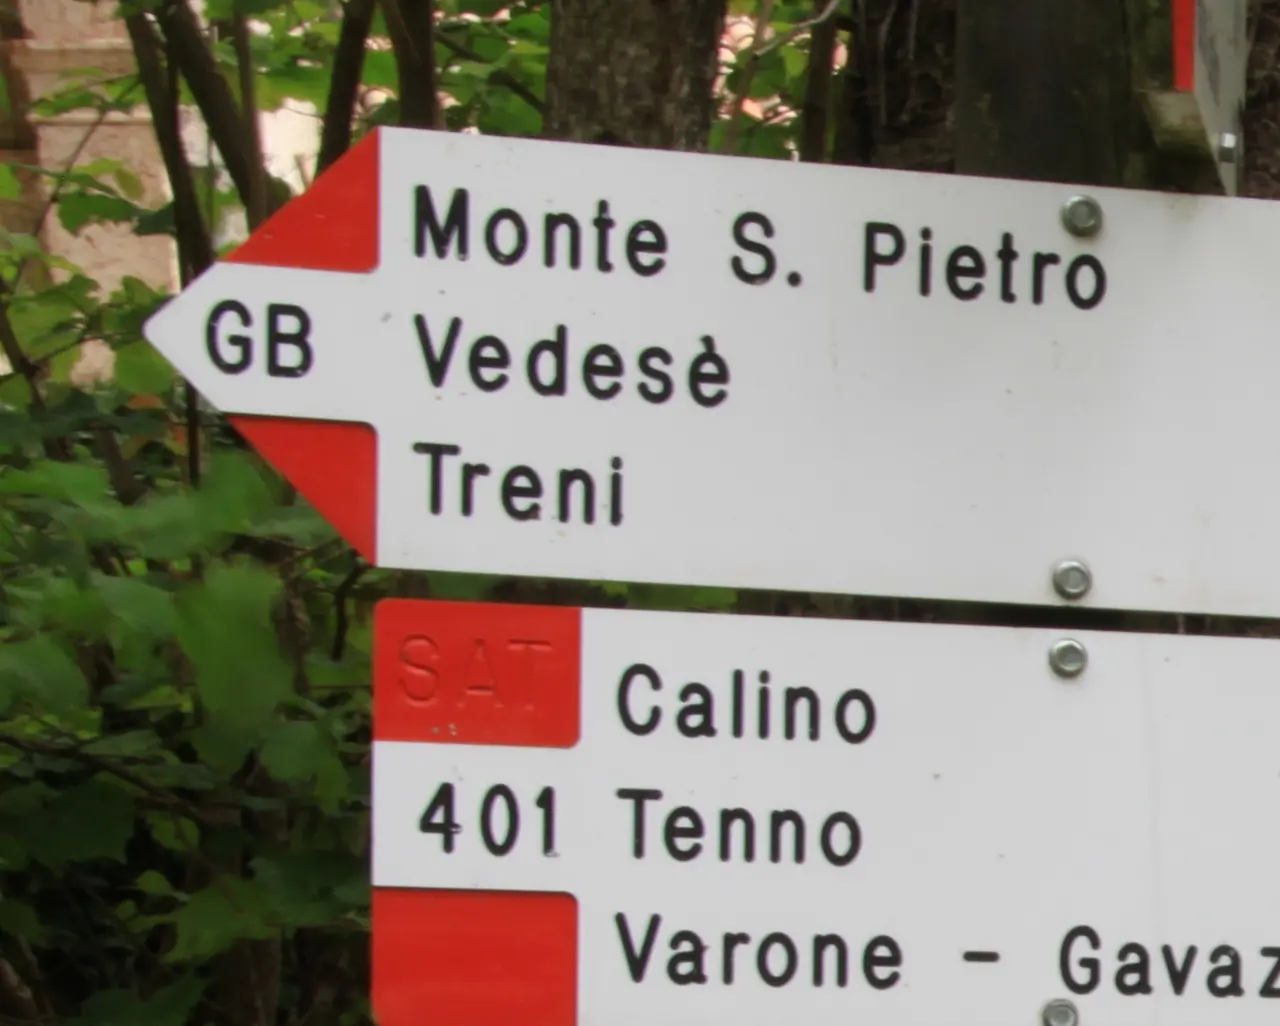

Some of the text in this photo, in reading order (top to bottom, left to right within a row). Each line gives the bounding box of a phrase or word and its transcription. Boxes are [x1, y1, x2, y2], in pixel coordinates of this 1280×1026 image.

[413, 184, 669, 279] Monte
[731, 211, 803, 289] S.
[864, 221, 1108, 312] Pietro
[205, 299, 314, 379] GB
[414, 313, 731, 409] Vedesè
[412, 442, 624, 528] Treni
[398, 633, 552, 711] SAT
[616, 662, 877, 746] Calino
[419, 782, 556, 858] 401
[616, 788, 863, 868] Tenno
[614, 911, 903, 991] Varone
